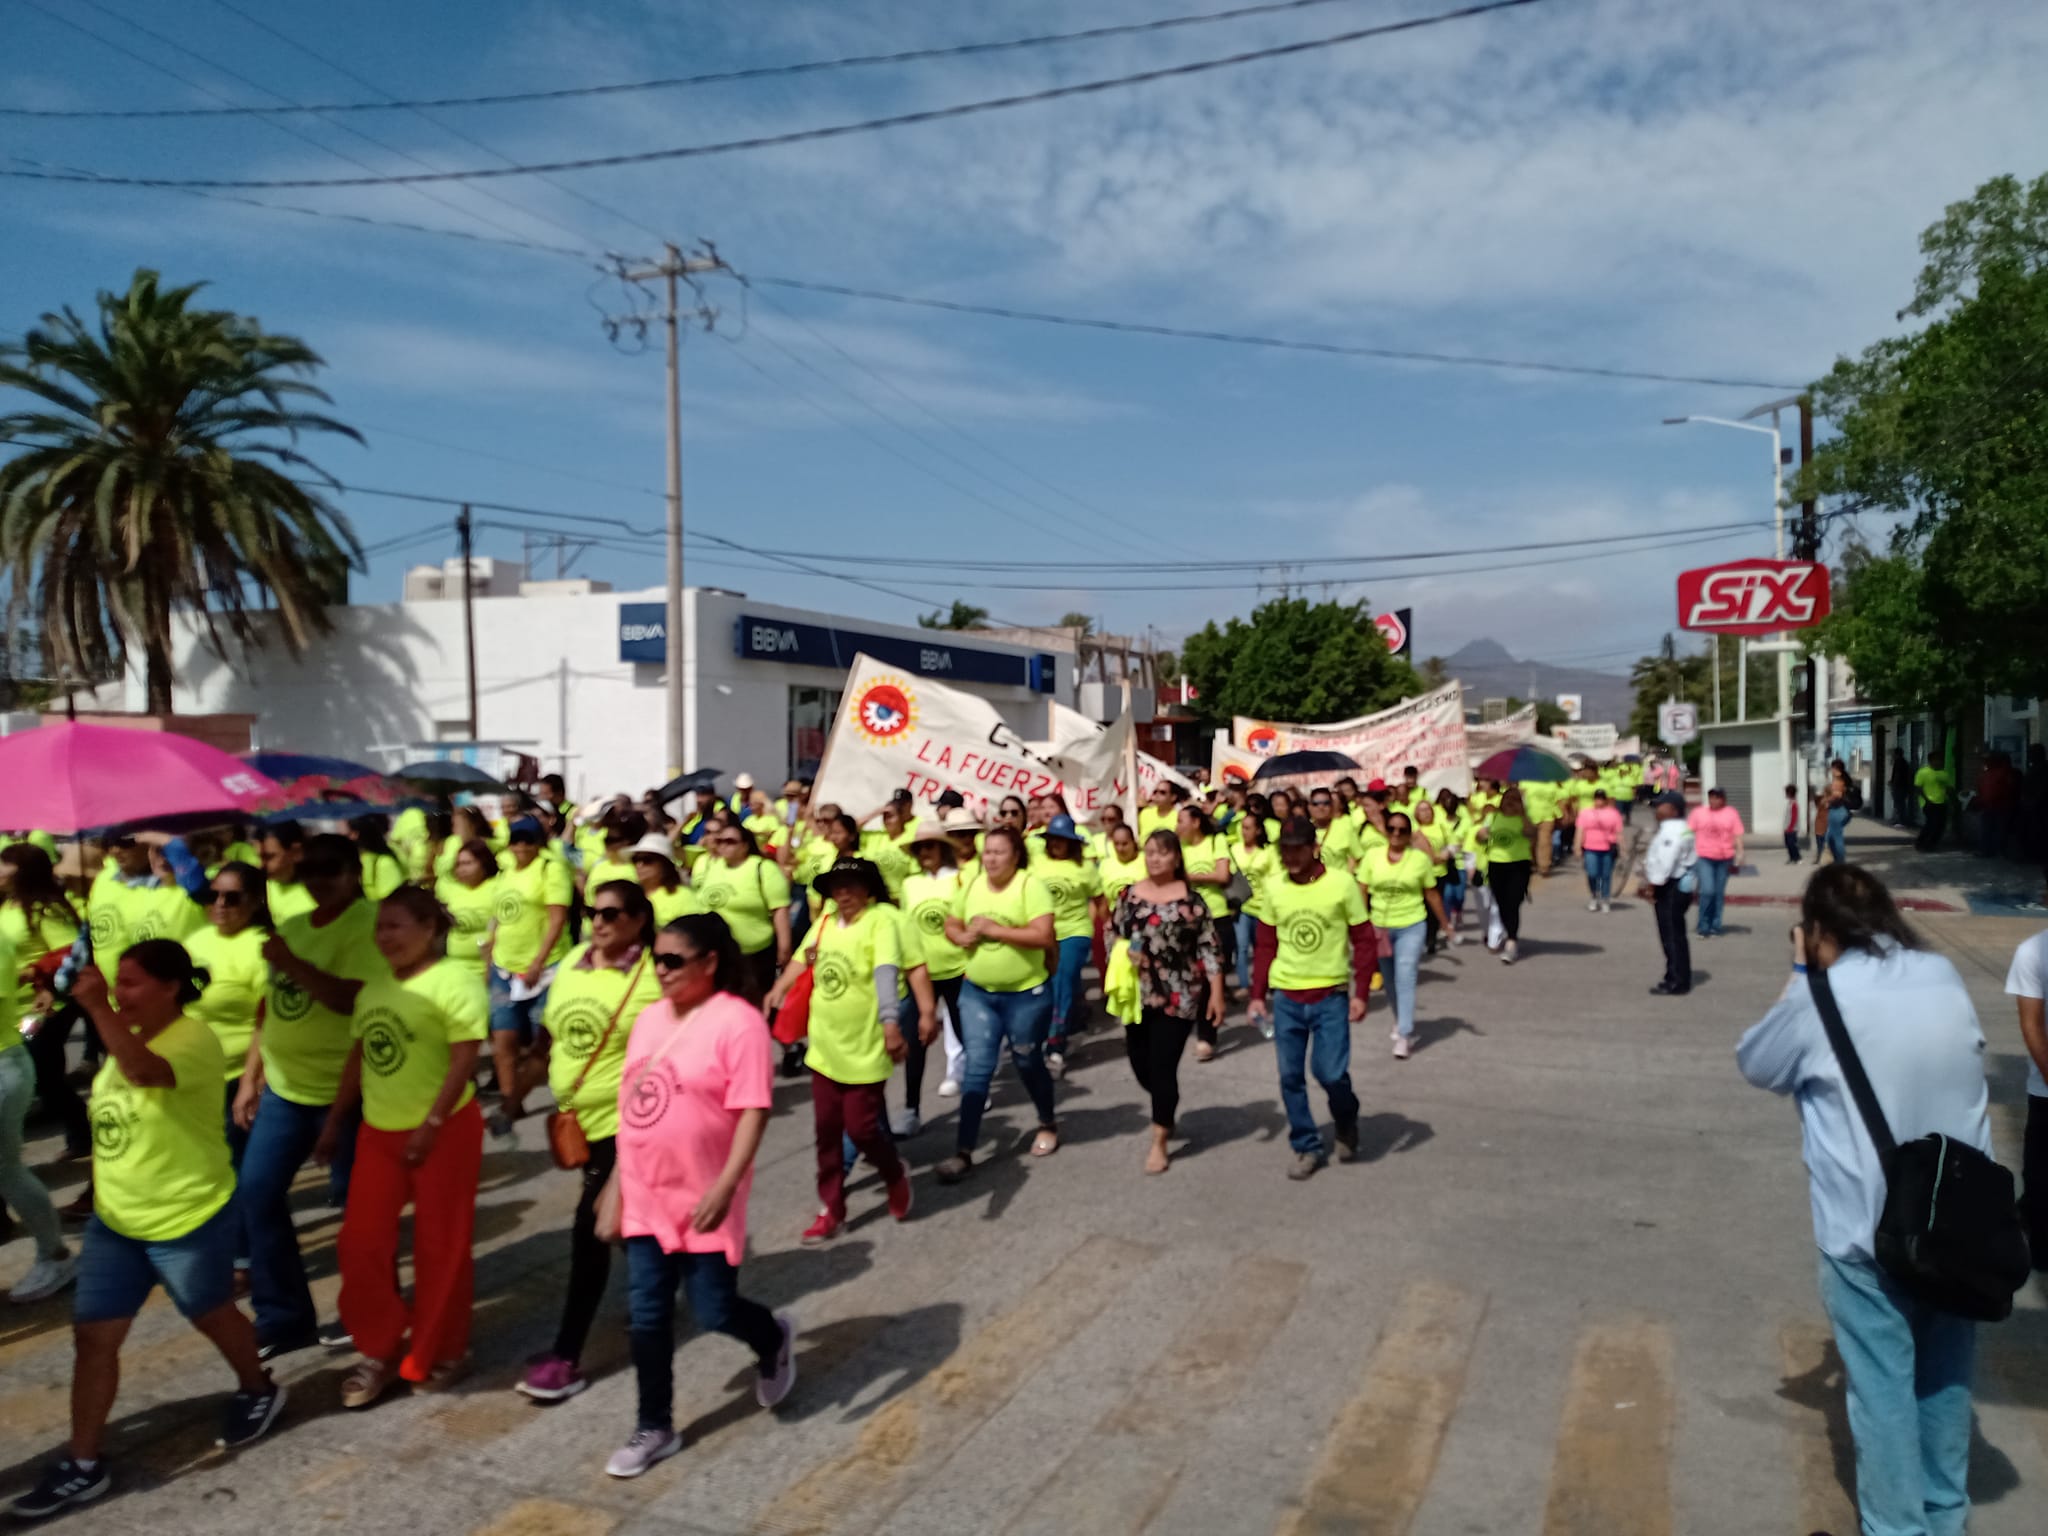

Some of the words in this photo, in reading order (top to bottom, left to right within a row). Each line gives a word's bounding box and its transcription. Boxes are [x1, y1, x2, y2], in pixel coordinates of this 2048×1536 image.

[621, 623, 666, 641] BBVA
[751, 626, 799, 652] BBVA
[920, 649, 953, 671] BBVA
[1672, 713, 1686, 731] E
[917, 739, 951, 769] LA
[959, 753, 1064, 798] FUERZA
